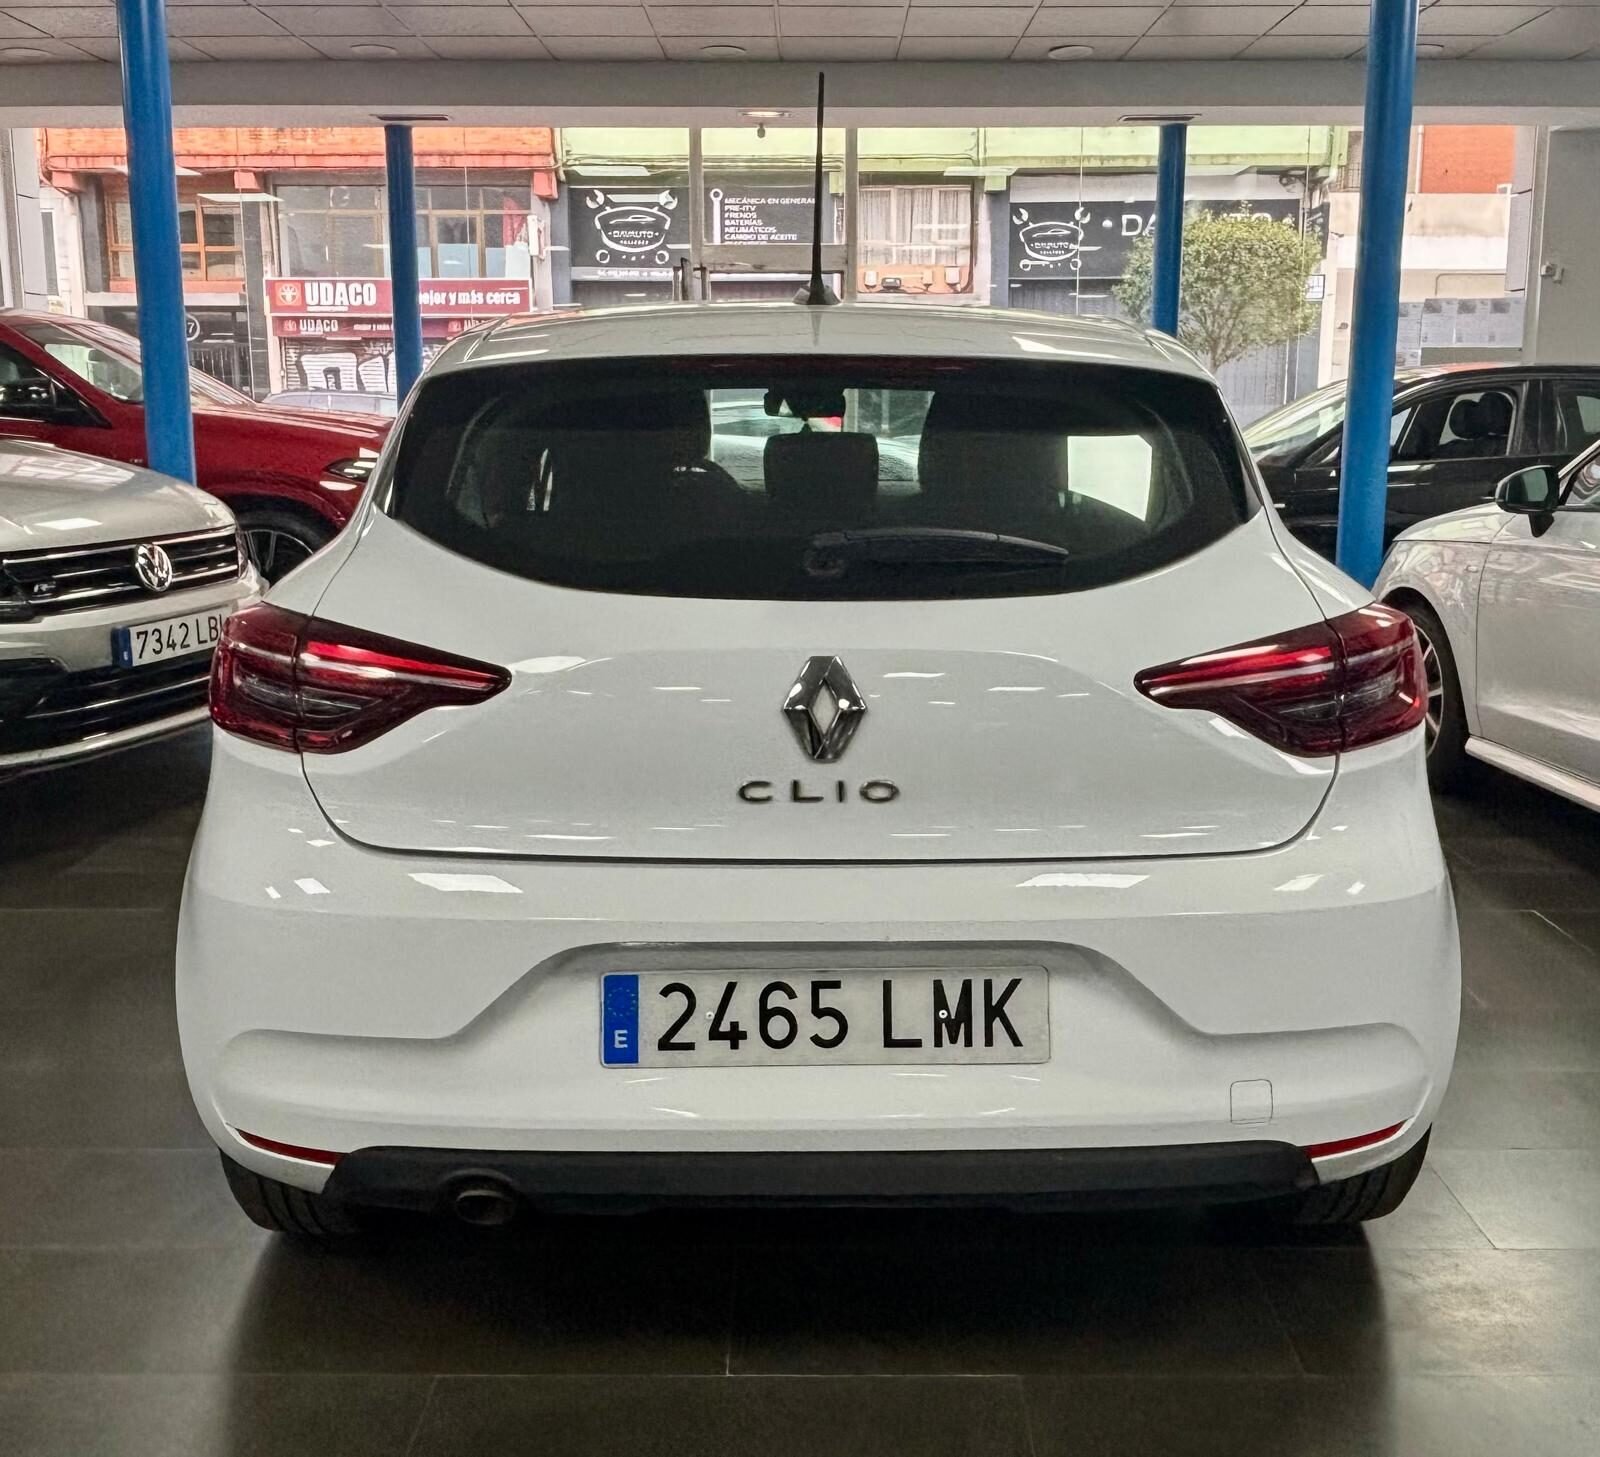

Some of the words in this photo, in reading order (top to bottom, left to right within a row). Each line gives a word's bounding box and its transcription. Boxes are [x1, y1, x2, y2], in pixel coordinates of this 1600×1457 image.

[304, 282, 377, 306] UDACO
[418, 289, 447, 306] ejor
[486, 291, 521, 305] cerca
[299, 319, 339, 332] UDACO
[136, 622, 191, 660] 7342
[736, 778, 901, 804] CLIO
[657, 979, 849, 1051] 2465
[882, 977, 1024, 1049] LMK
[613, 1029, 629, 1049] E
